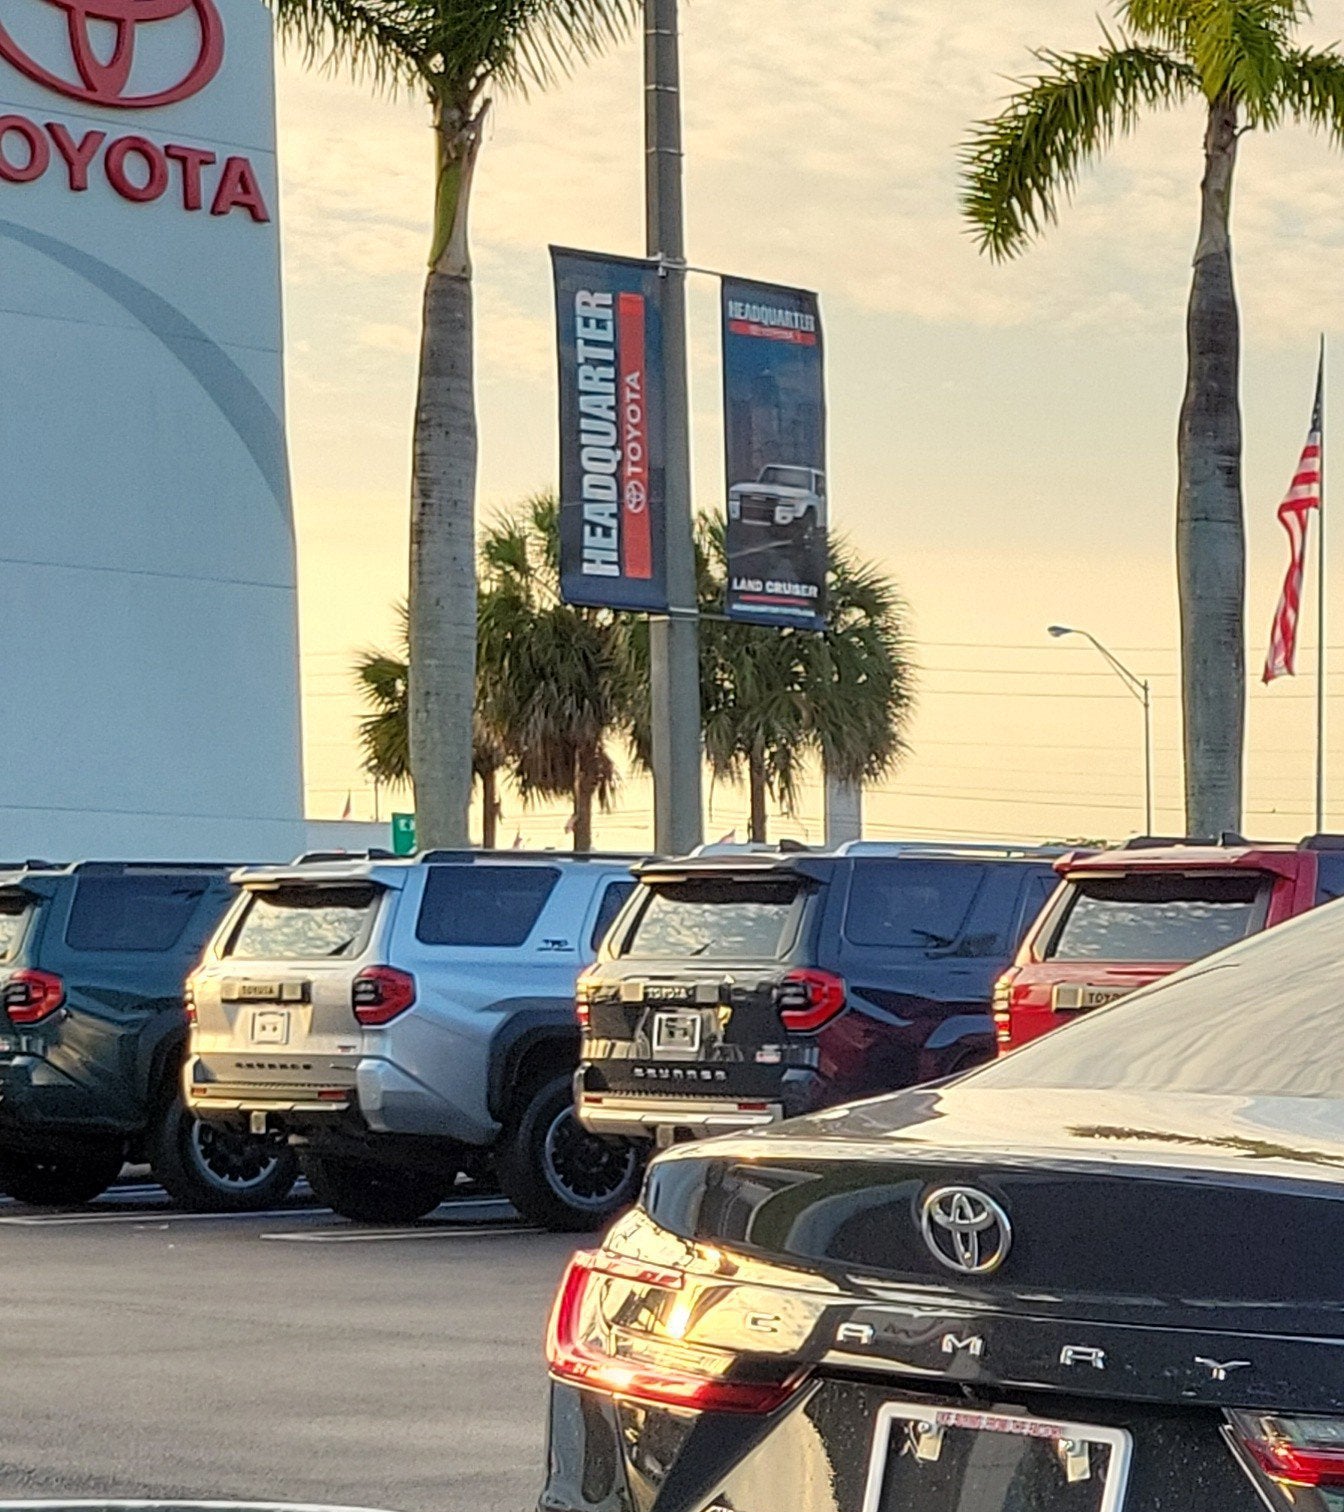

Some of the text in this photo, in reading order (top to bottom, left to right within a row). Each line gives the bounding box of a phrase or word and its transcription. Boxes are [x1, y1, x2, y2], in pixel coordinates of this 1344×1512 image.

[575, 290, 622, 577] HEADQUARTER
[625, 371, 643, 476] TOYOTA
[732, 577, 763, 592] LAND
[744, 1310, 1252, 1381] CAMRY
